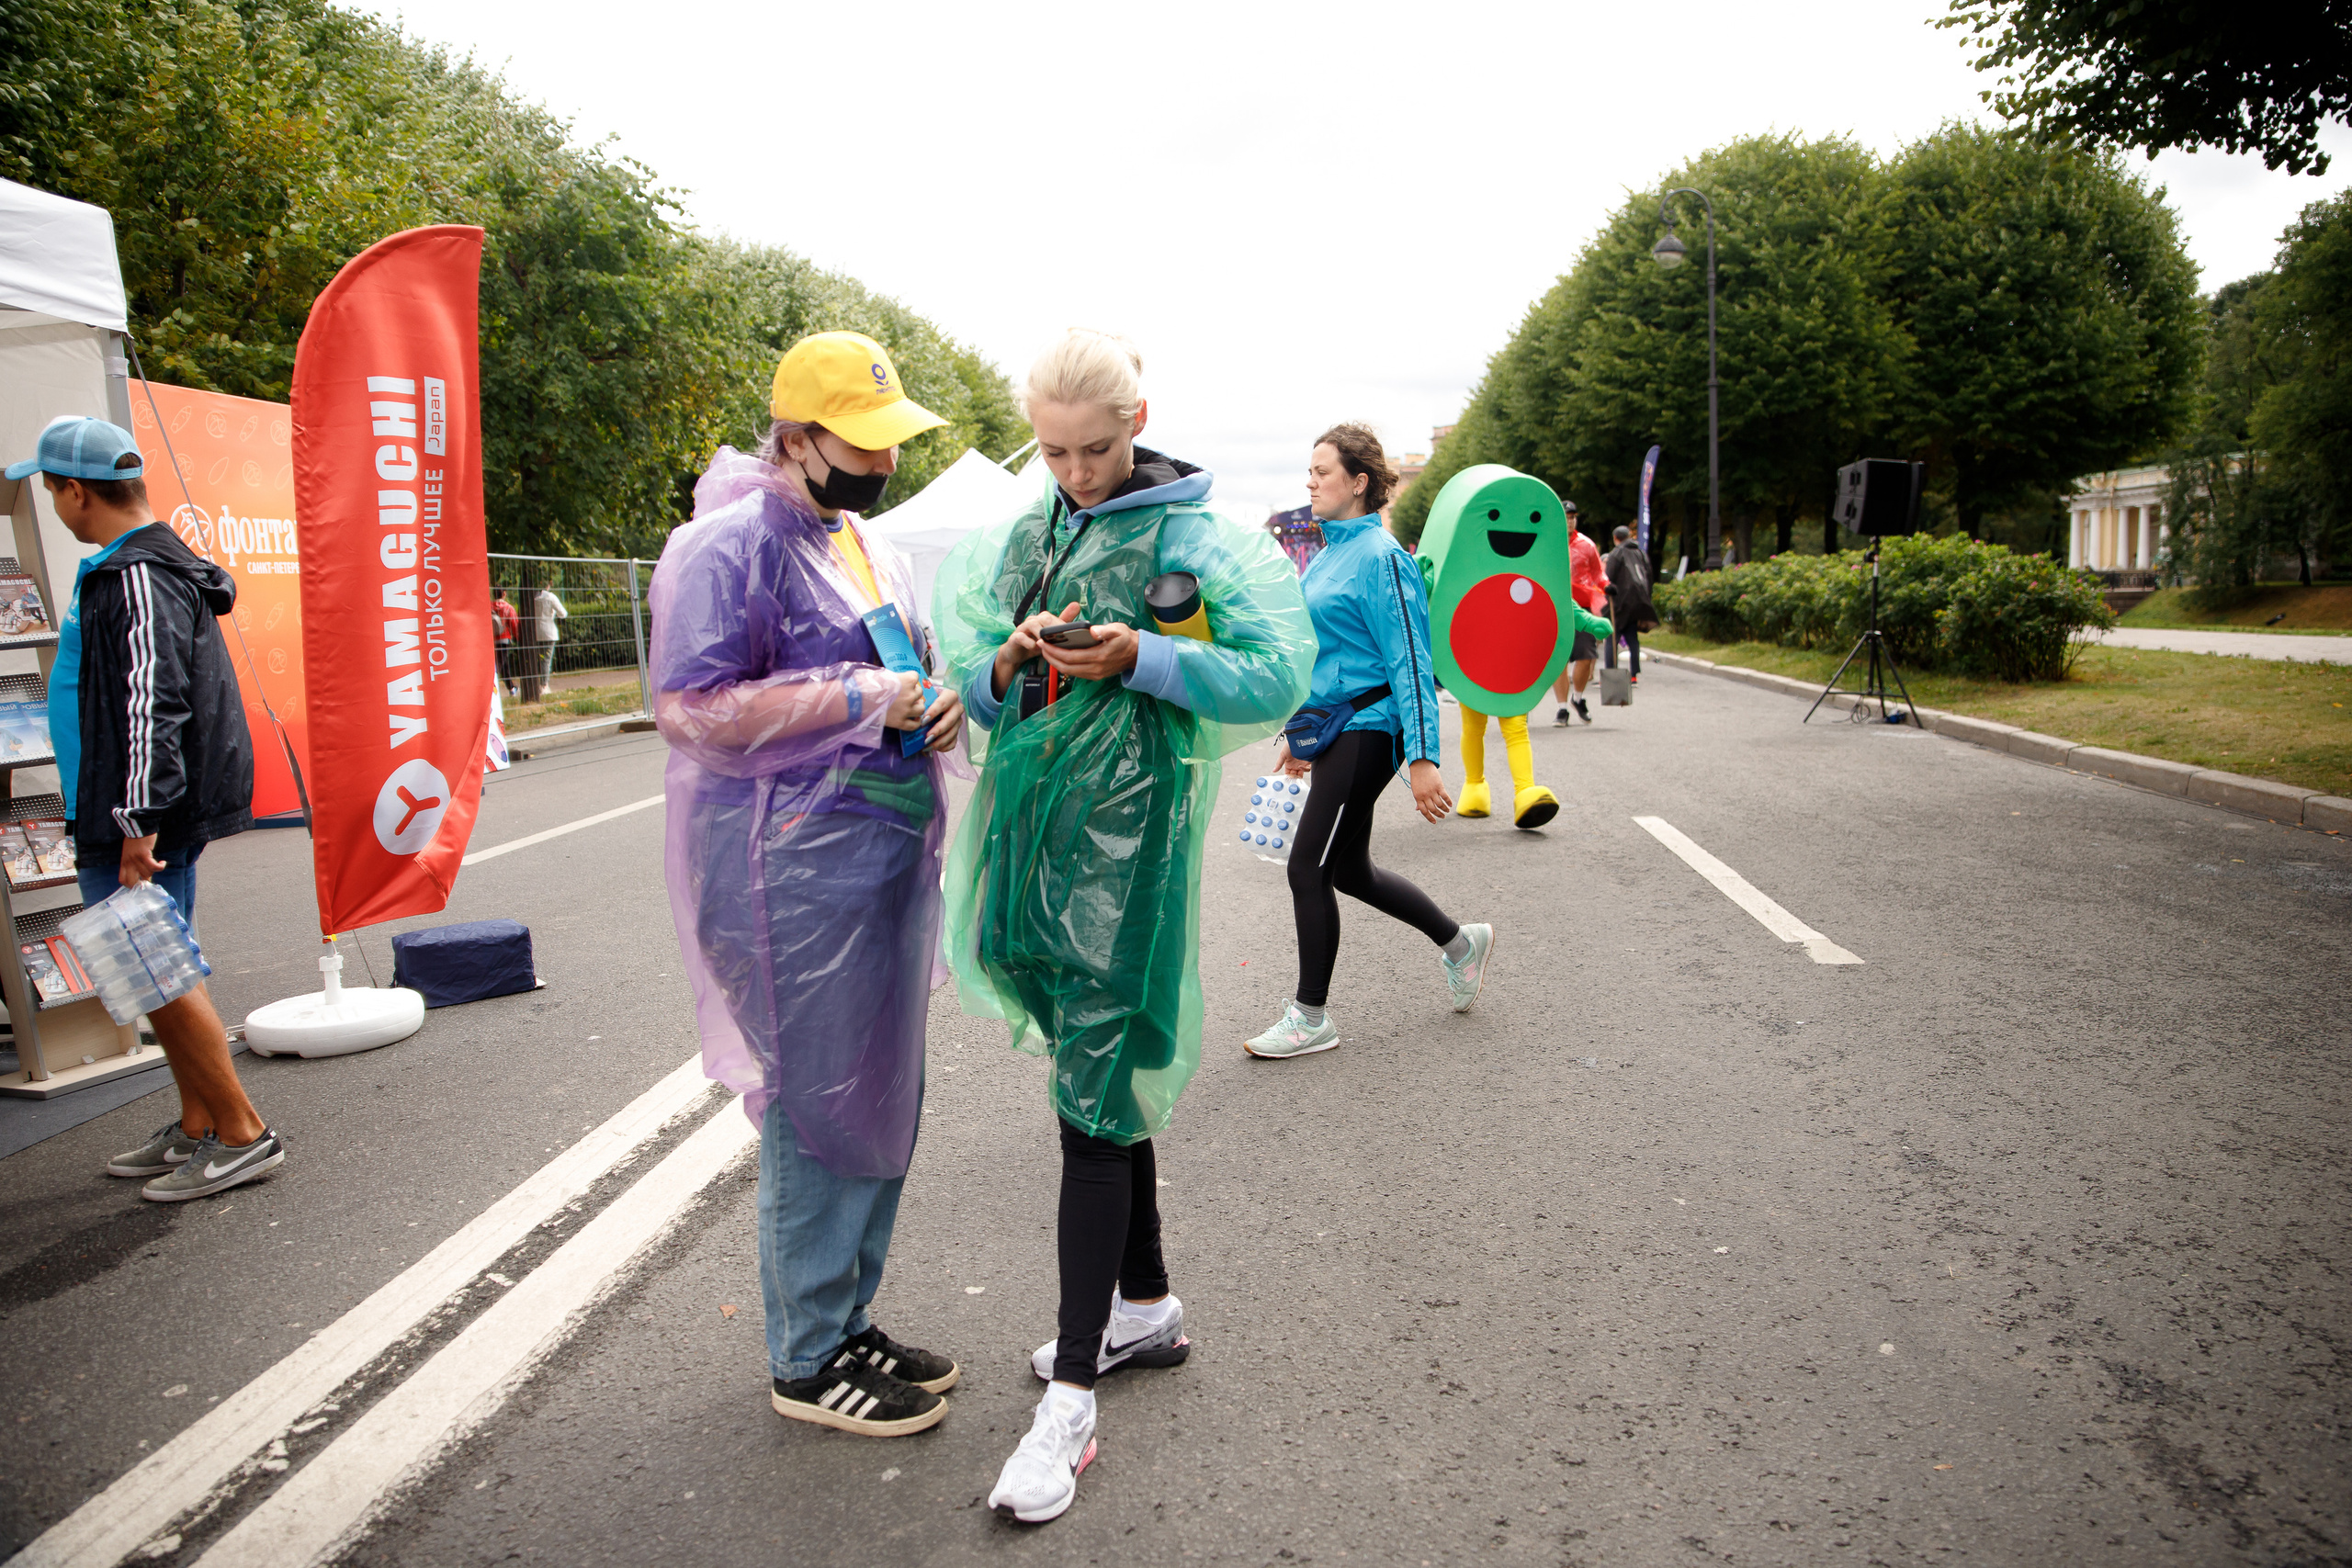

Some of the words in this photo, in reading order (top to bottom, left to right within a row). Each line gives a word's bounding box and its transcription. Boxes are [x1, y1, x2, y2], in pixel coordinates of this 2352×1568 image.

[428, 386, 444, 448] Japan
[218, 504, 299, 567] фонта
[367, 376, 428, 750] YAMAGUCHI
[424, 468, 443, 573] ЛУЧШЕЕ
[424, 578, 449, 682] ТОЛЬКО
